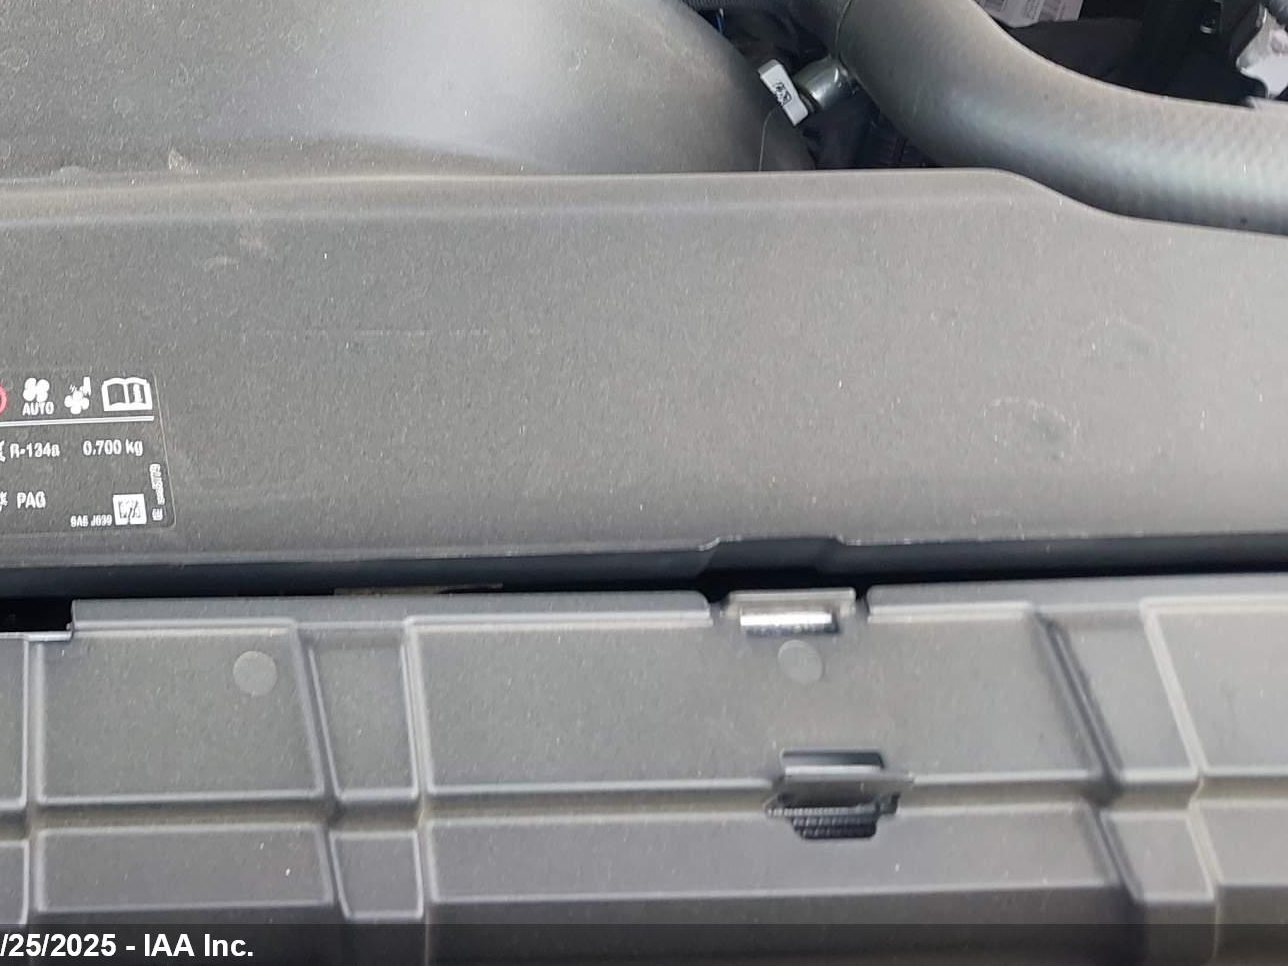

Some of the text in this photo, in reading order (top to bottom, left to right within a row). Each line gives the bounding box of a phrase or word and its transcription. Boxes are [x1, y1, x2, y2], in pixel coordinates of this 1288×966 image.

[22, 401, 55, 416] AUTO
[9, 438, 144, 458] R-134a 0.700 kg
[16, 490, 47, 509] PAG
